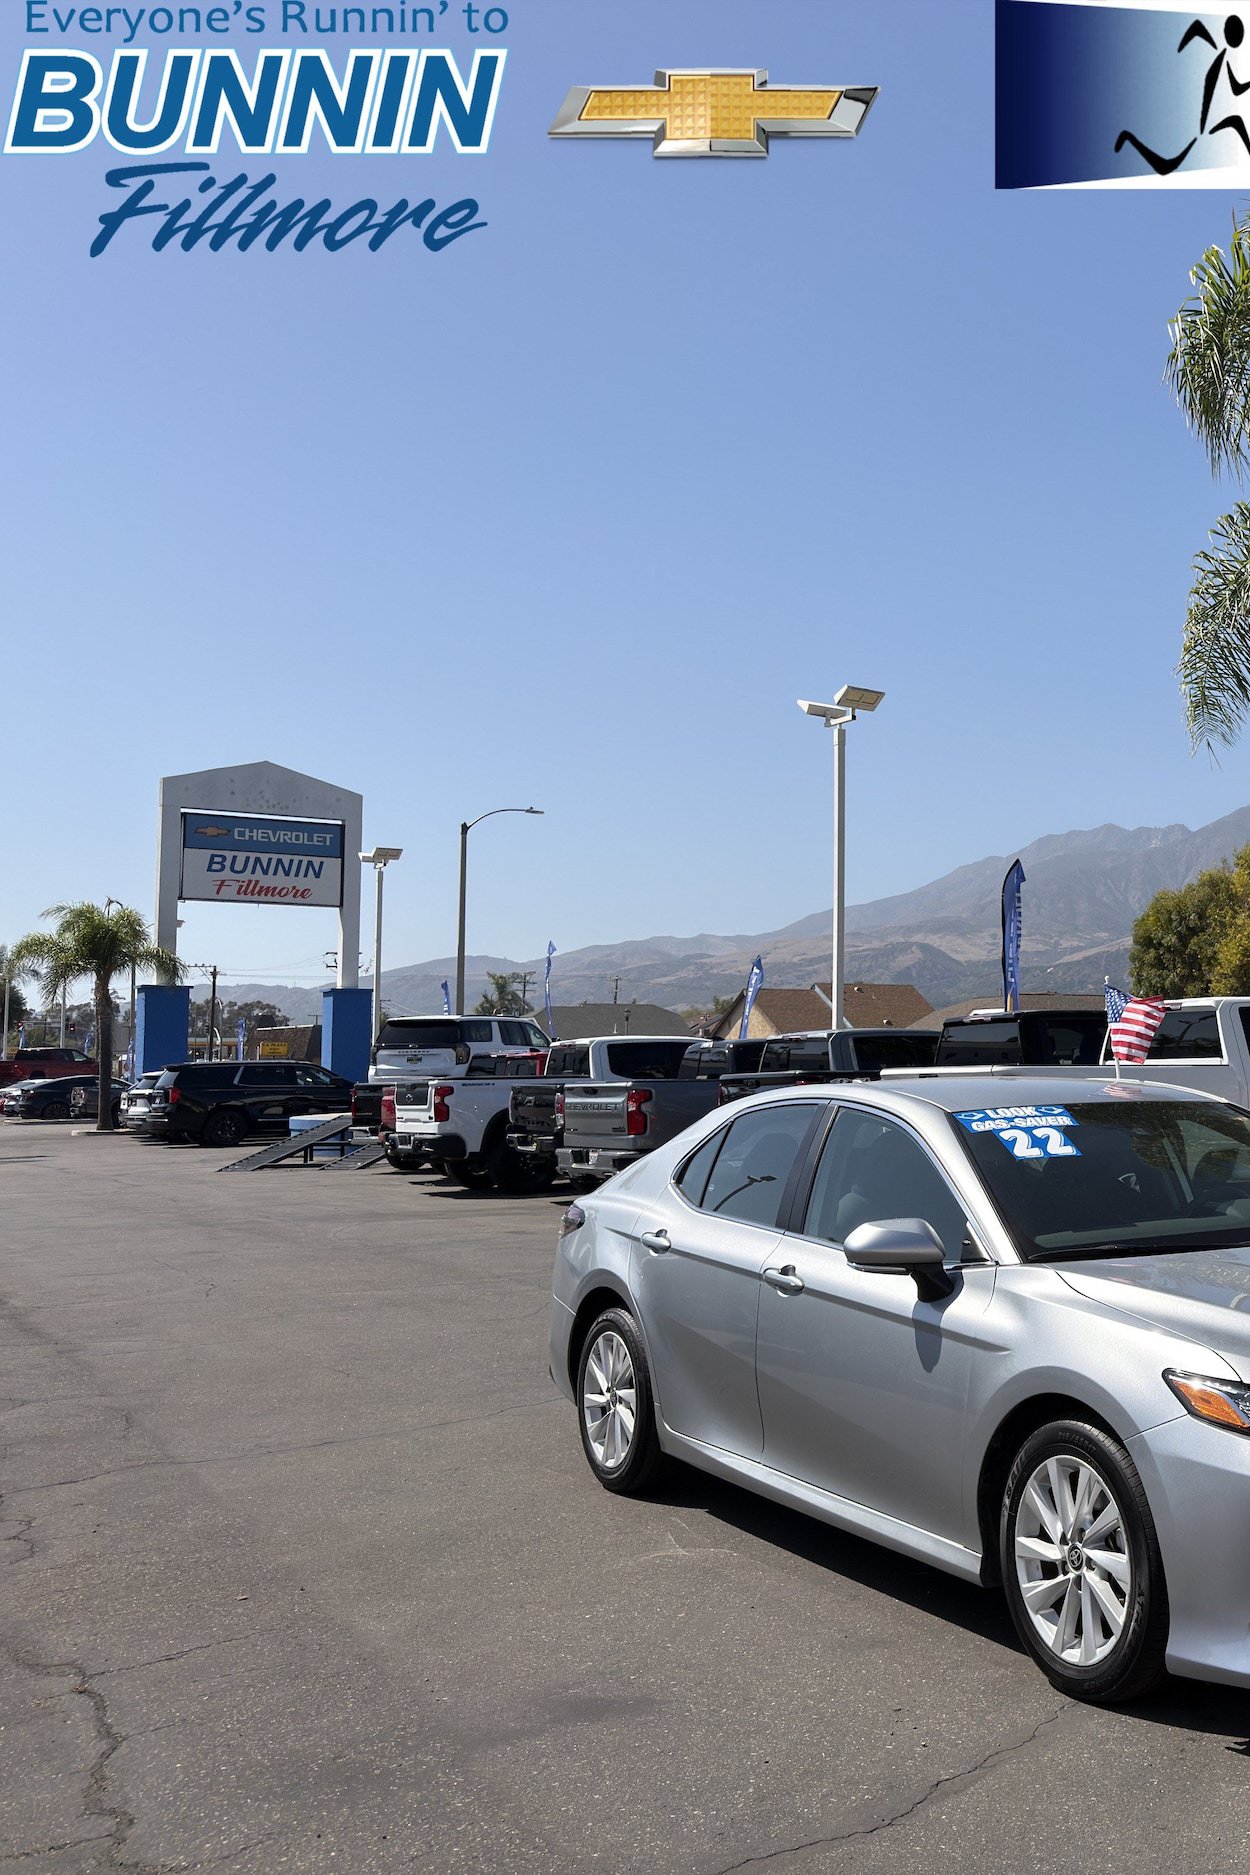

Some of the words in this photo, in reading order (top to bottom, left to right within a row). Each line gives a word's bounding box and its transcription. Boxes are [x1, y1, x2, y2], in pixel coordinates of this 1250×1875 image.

[233, 827, 334, 846] CHEVROLET
[206, 853, 324, 879] BUNNIN
[211, 879, 313, 900] Fillmore
[565, 1103, 619, 1112] CHEVROLET
[984, 1106, 1042, 1119] LOOK
[971, 1115, 1073, 1132] GAS-SAVER
[998, 1127, 1077, 1157] 22
